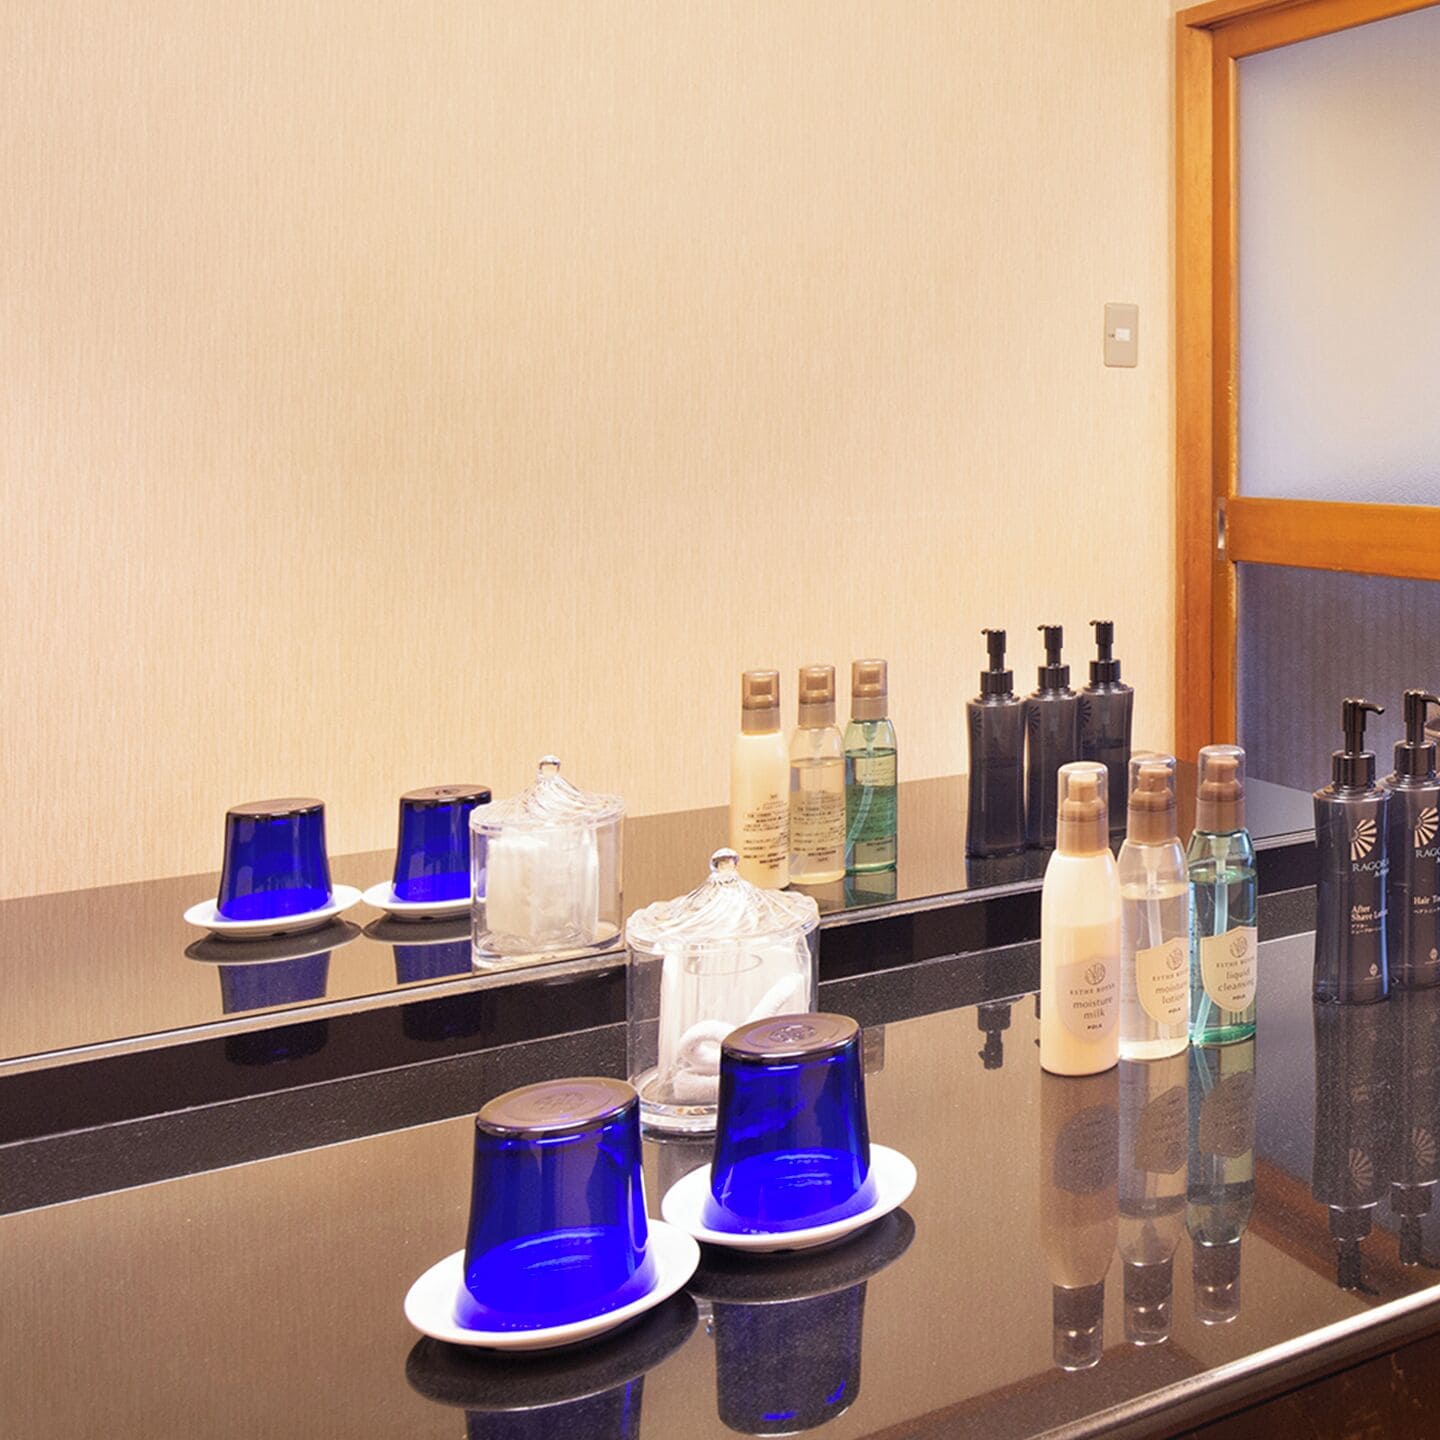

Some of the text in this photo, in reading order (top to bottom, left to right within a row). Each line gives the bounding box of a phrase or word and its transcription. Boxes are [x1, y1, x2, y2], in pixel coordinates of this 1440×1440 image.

[1413, 895, 1431, 905] Hair
[1351, 904, 1371, 913] After
[1351, 912, 1373, 922] Shave
[1225, 968, 1250, 980] liquid
[1072, 997, 1113, 1009] moisture
[1083, 1008, 1106, 1020] milk
